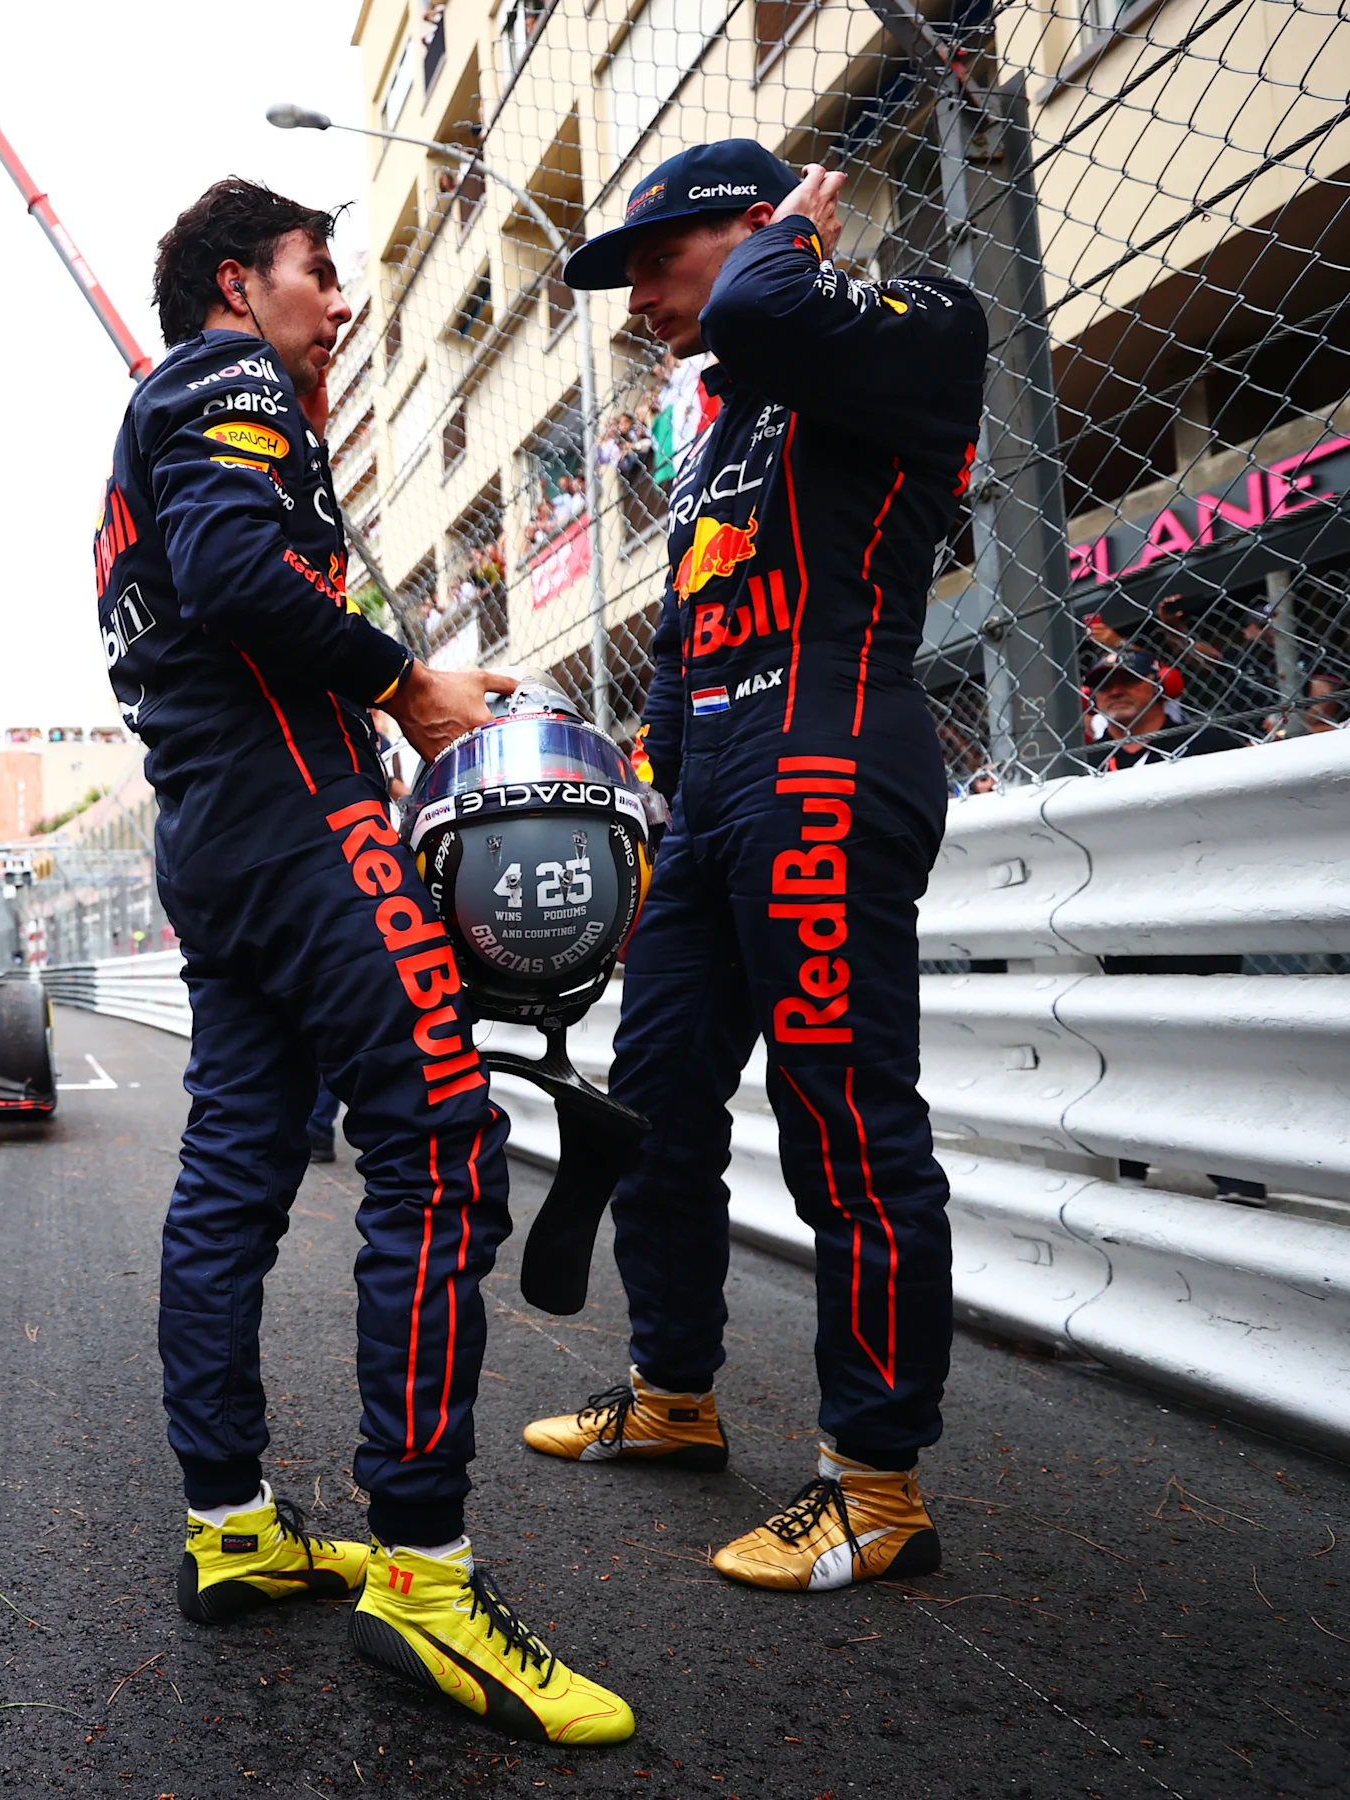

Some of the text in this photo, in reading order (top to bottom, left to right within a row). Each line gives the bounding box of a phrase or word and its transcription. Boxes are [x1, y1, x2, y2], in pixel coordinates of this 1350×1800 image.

[688, 183, 757, 200] CarNext
[186, 357, 280, 391] Mobil
[228, 431, 279, 454] RAUCH
[735, 668, 784, 700] MAX
[461, 782, 612, 814] ORACLE
[434, 831, 456, 876] telcel
[617, 824, 635, 867] Claro
[493, 857, 593, 908] 4 25
[495, 906, 587, 921] WINS PODIUMS
[471, 924, 544, 973] GRACIAS
[550, 921, 605, 970] PEDRO
[502, 926, 577, 938] AND COUNTING!
[518, 1004, 545, 1015] 11
[388, 1565, 415, 1595] 11
